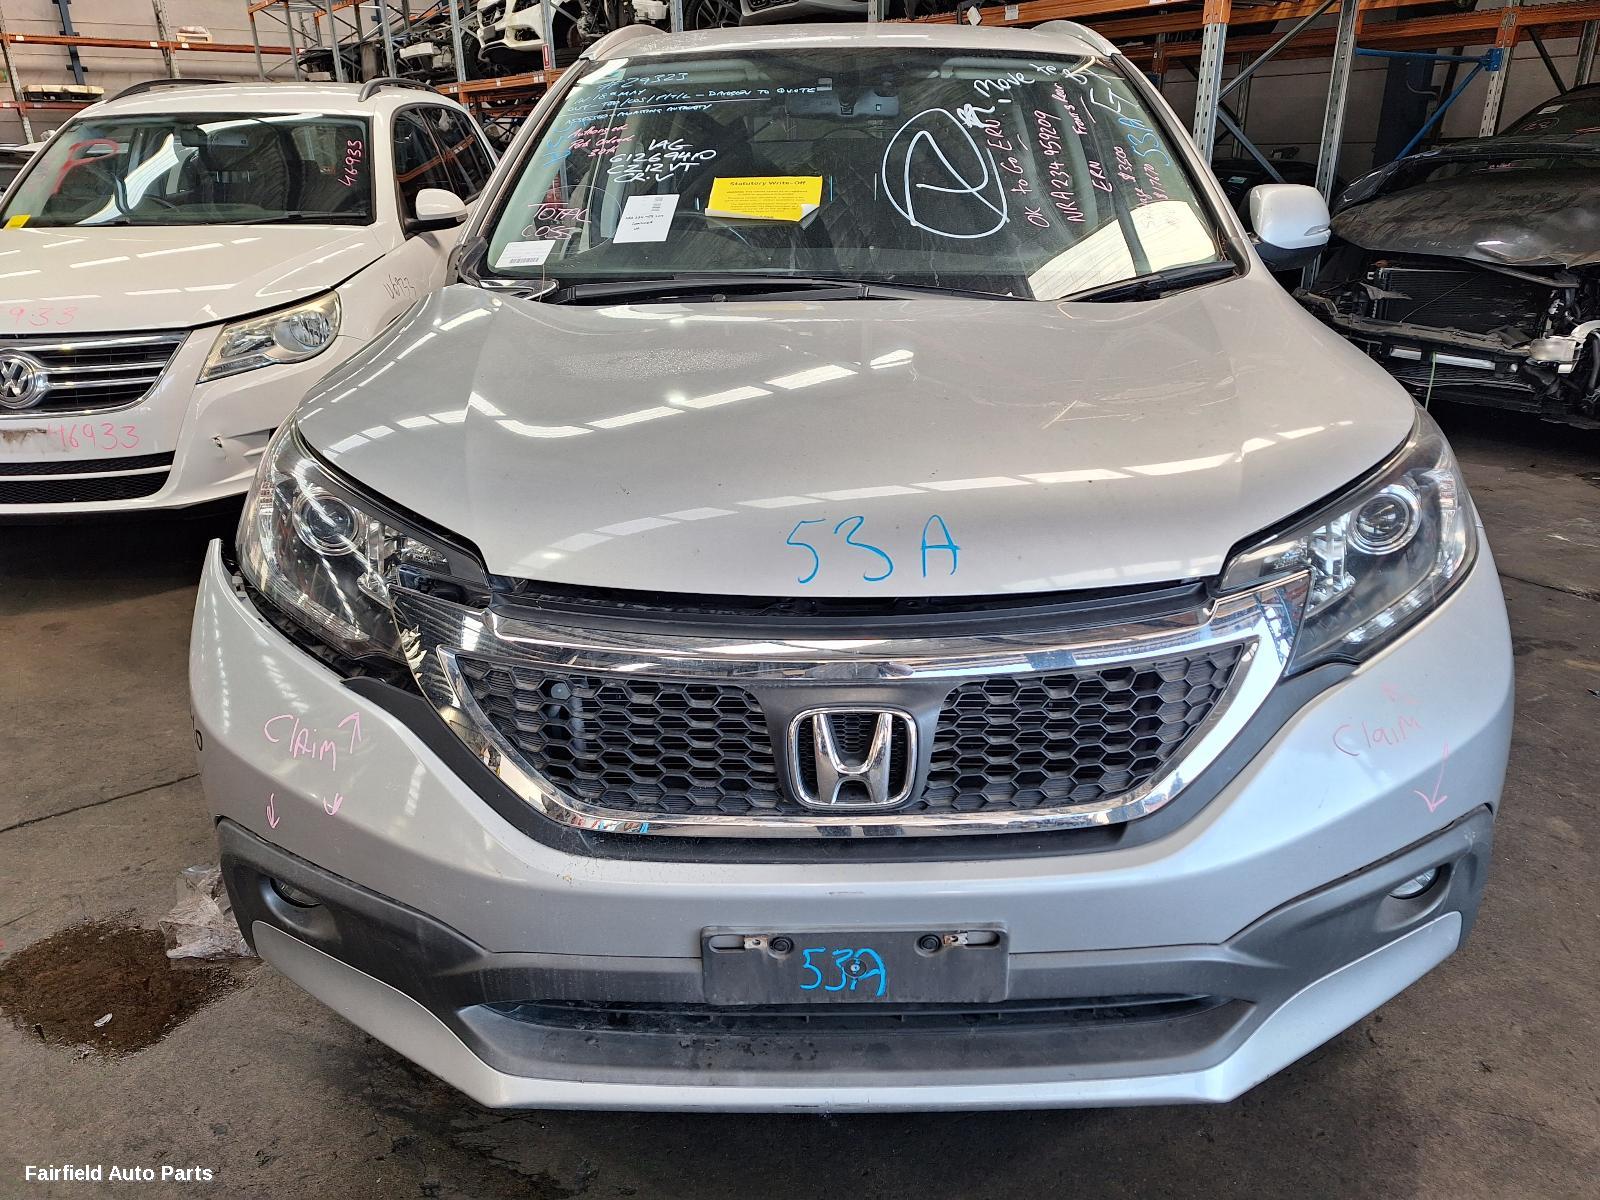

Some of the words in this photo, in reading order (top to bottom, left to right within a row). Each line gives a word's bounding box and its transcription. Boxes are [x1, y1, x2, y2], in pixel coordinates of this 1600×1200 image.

[973, 71, 1036, 98] Move
[1118, 116, 1171, 167] 53A
[337, 139, 363, 187] 46933
[1088, 160, 1114, 193] ERN
[1010, 178, 1033, 195] to
[527, 202, 593, 224] TOTAL
[1024, 206, 1051, 228] OK
[47, 421, 141, 450] 46933
[800, 947, 888, 997] 53A
